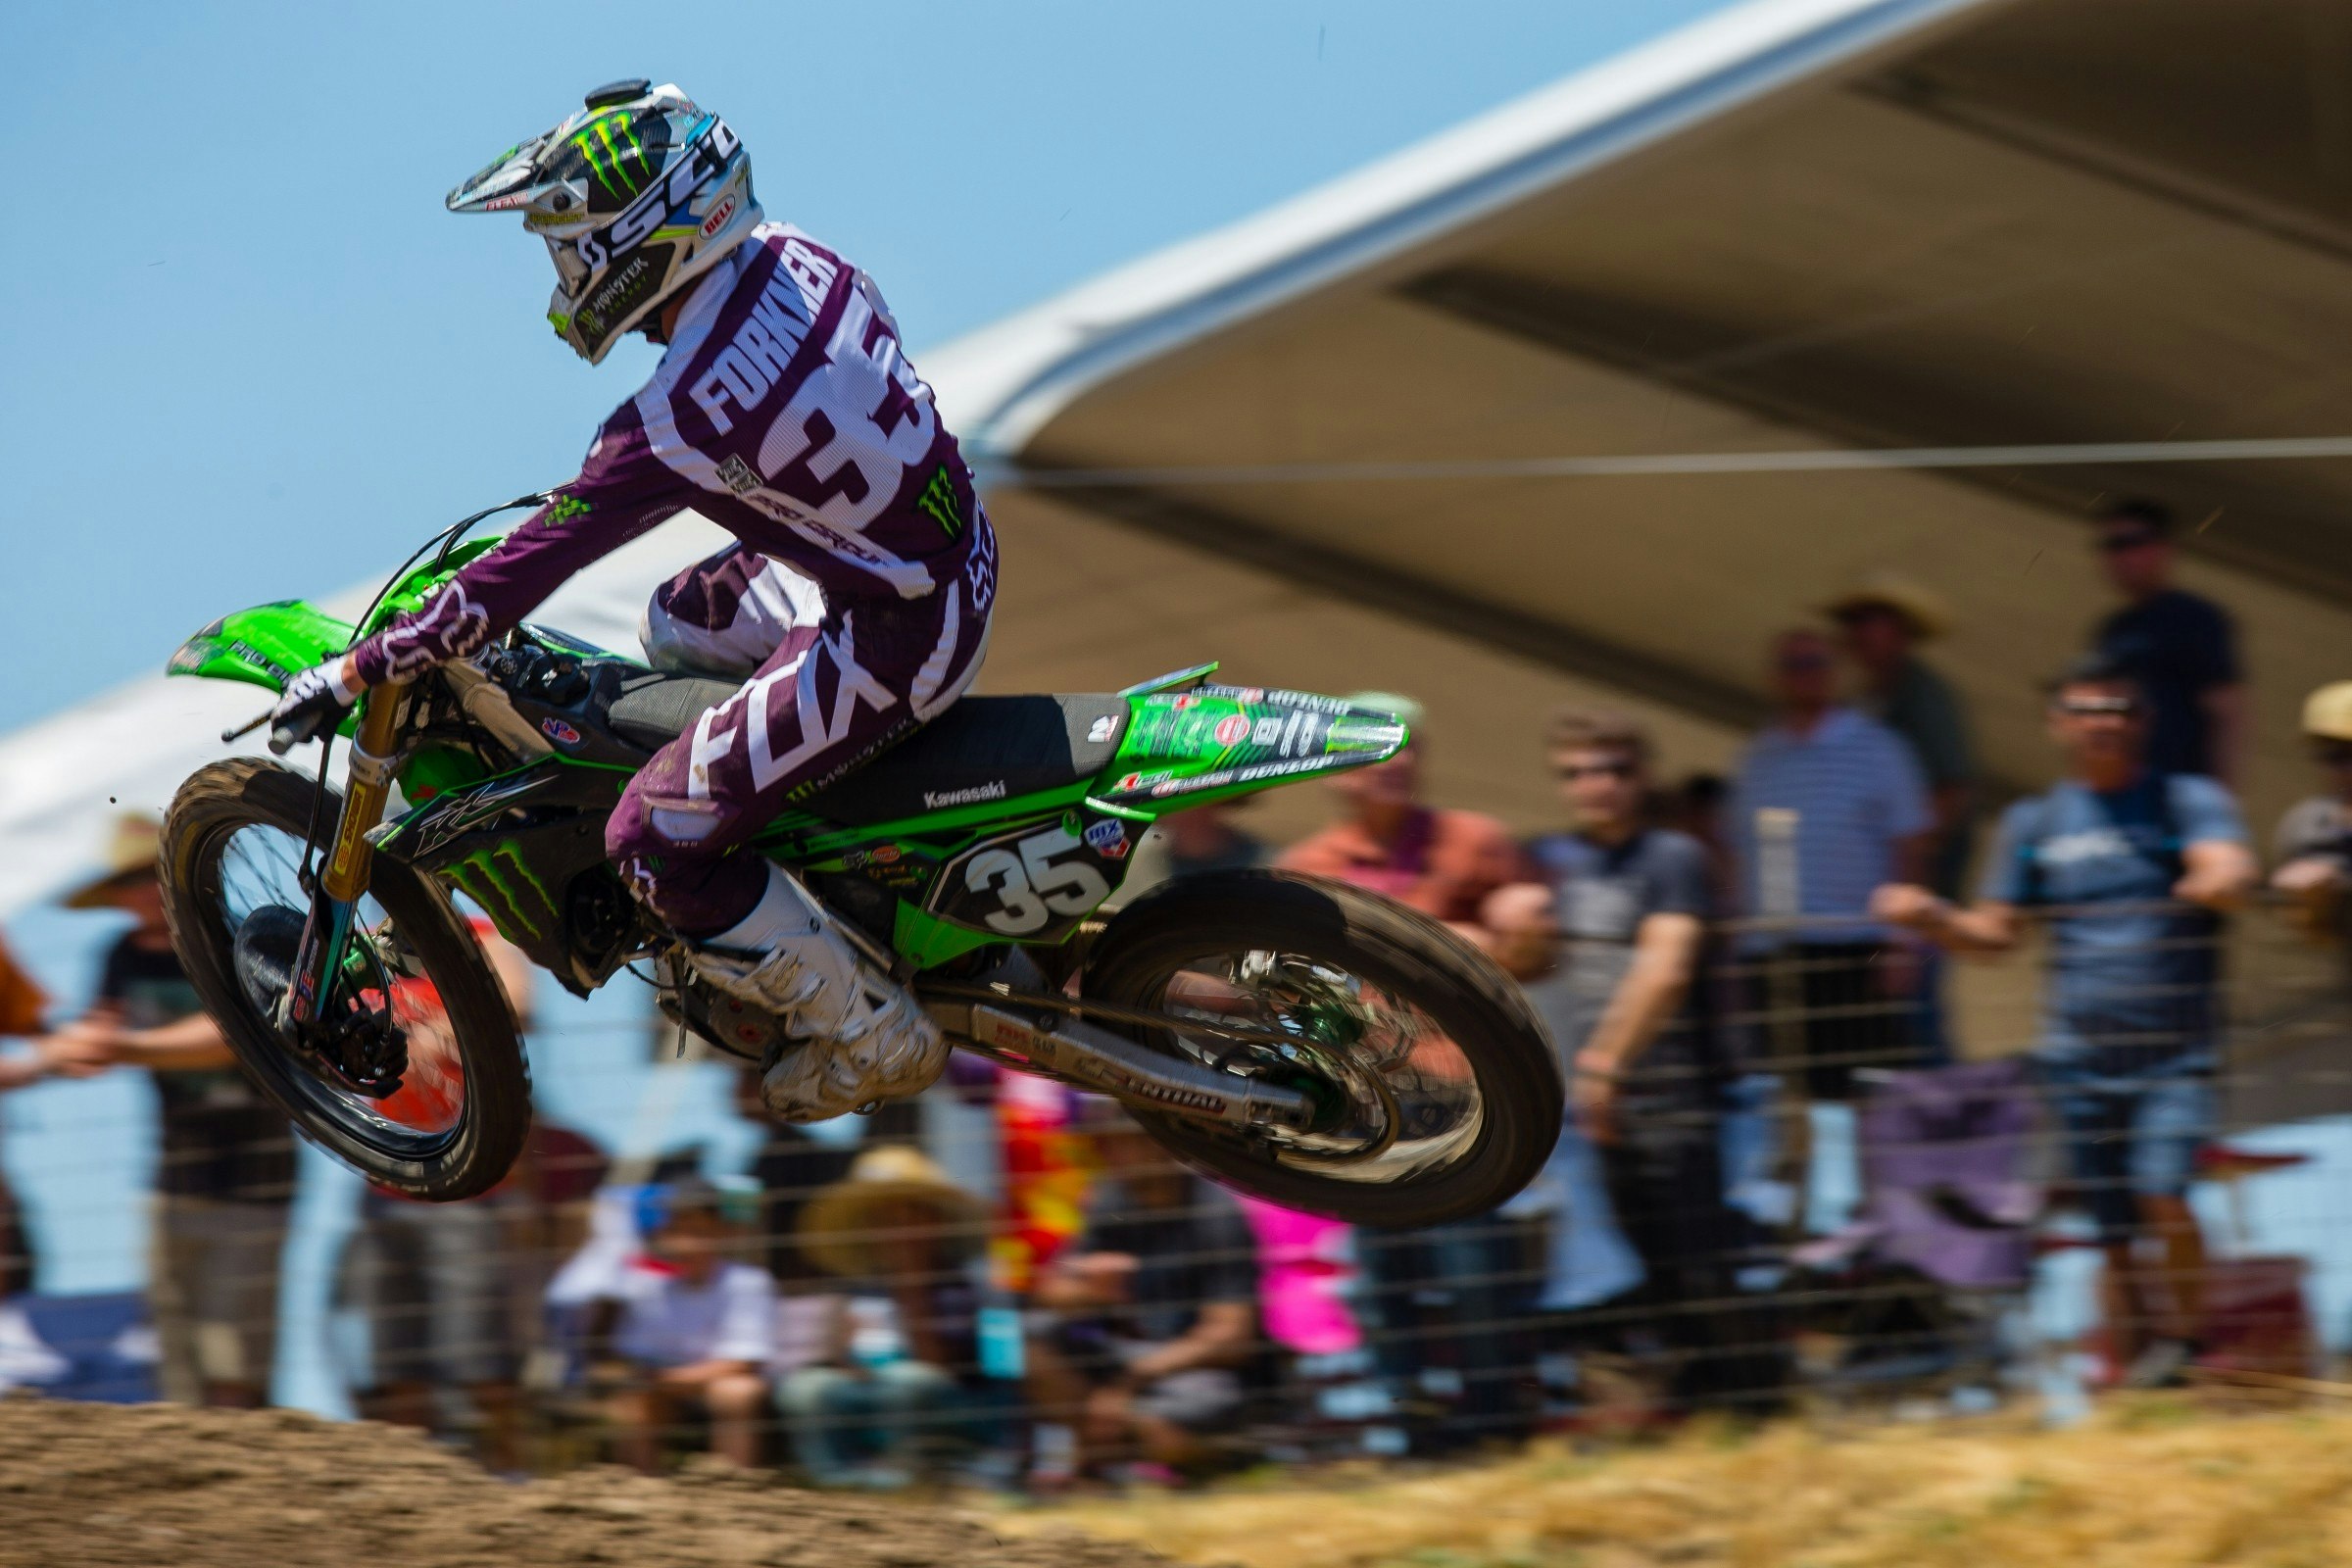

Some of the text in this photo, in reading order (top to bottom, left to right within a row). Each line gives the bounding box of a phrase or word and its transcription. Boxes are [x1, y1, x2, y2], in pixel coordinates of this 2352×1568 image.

[704, 200, 733, 236] BELL
[593, 256, 649, 313] MONSTER
[689, 238, 838, 437] FORKNER
[757, 282, 936, 533] 35
[228, 639, 268, 666] PRO
[688, 610, 898, 800] FOX
[924, 780, 1007, 808] Kawasaki
[1238, 755, 1335, 782] DUNLOP
[343, 790, 366, 845] SHOWA
[965, 827, 1109, 936] 35
